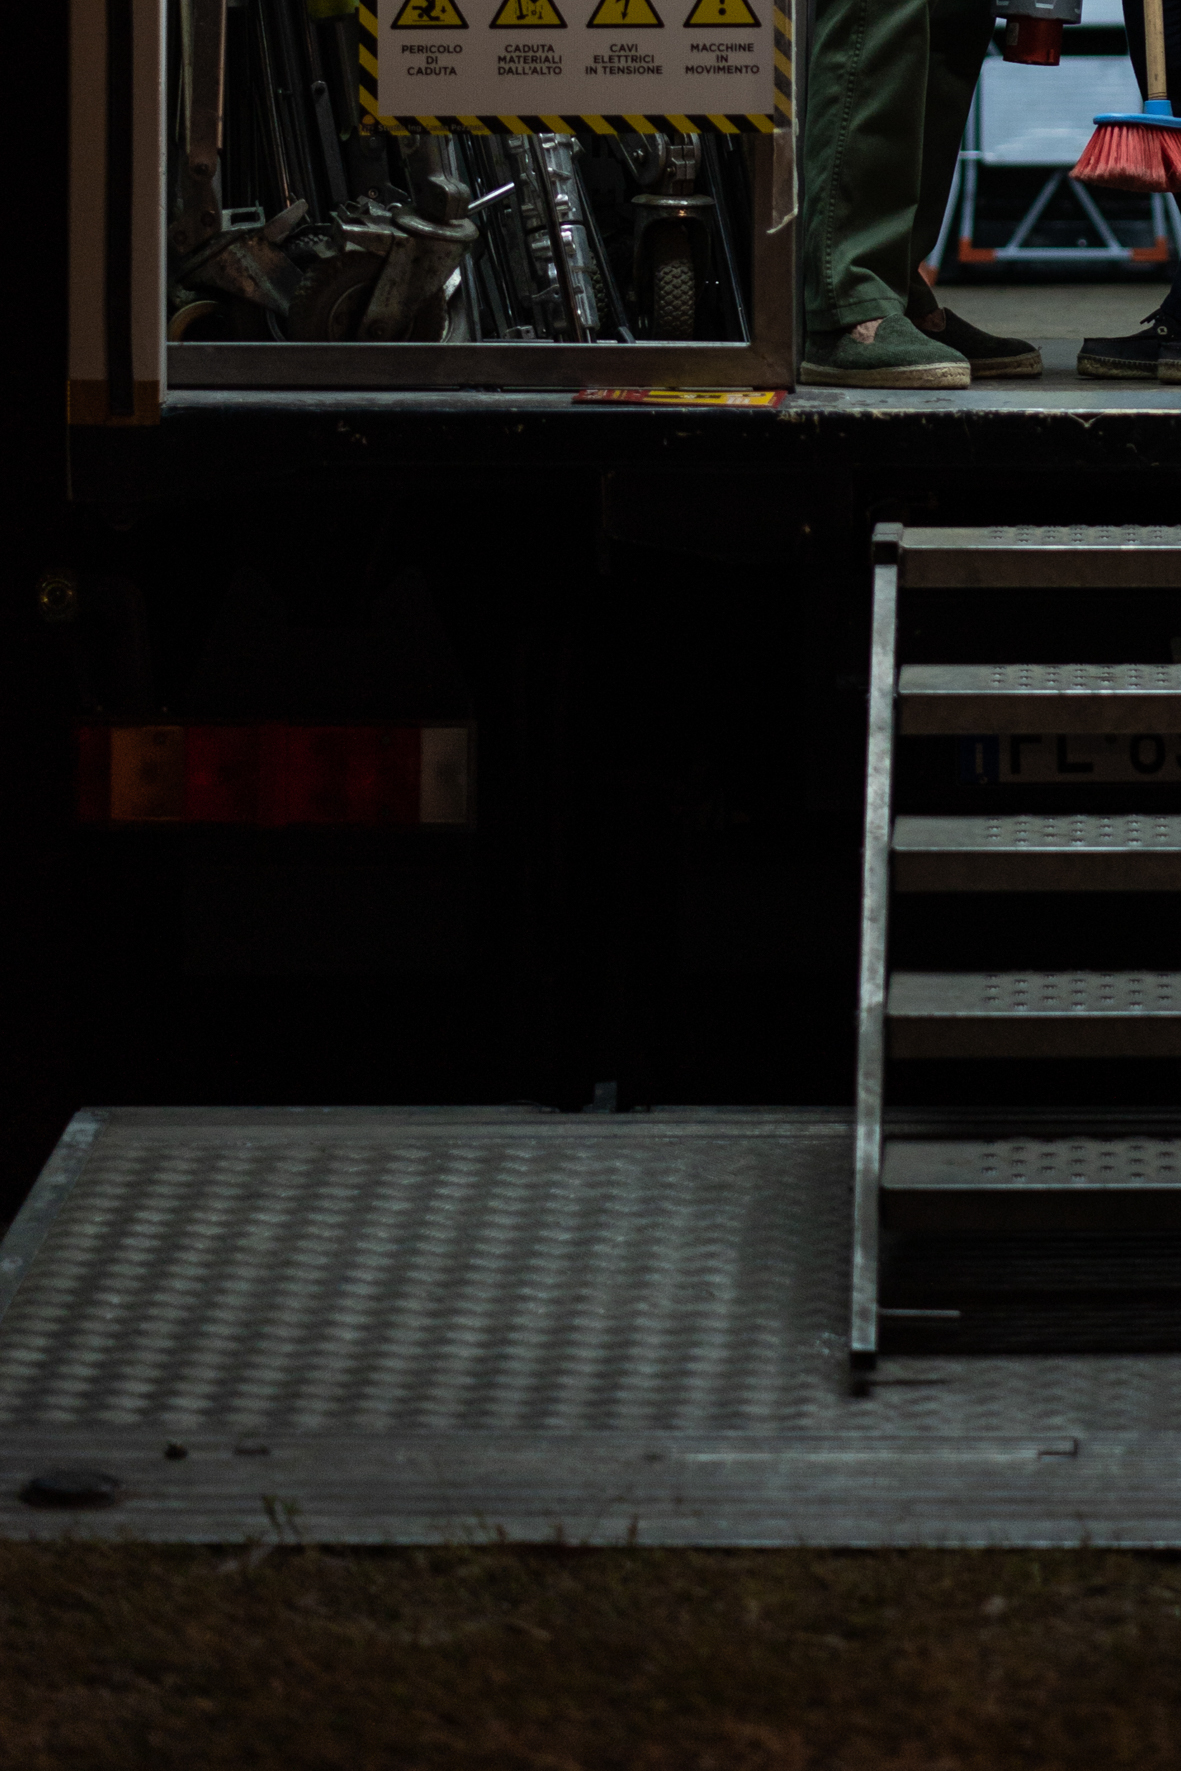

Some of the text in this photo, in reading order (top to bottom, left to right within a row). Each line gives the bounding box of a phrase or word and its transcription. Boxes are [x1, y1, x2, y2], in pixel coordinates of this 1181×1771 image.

[401, 44, 463, 54] PERICOLO
[504, 44, 555, 54] CADUTA
[610, 43, 638, 54] CAVI
[690, 43, 754, 53] MACCHINE
[426, 56, 438, 65] DI
[497, 55, 562, 65] MATERIALI
[593, 55, 655, 64] ELETTRICI
[716, 54, 729, 64] IN
[407, 66, 457, 76] CADUTA
[497, 66, 562, 76] DALL'ALTO
[585, 66, 663, 75] IN TENSIONE
[685, 65, 760, 75] MOVIMENTO
